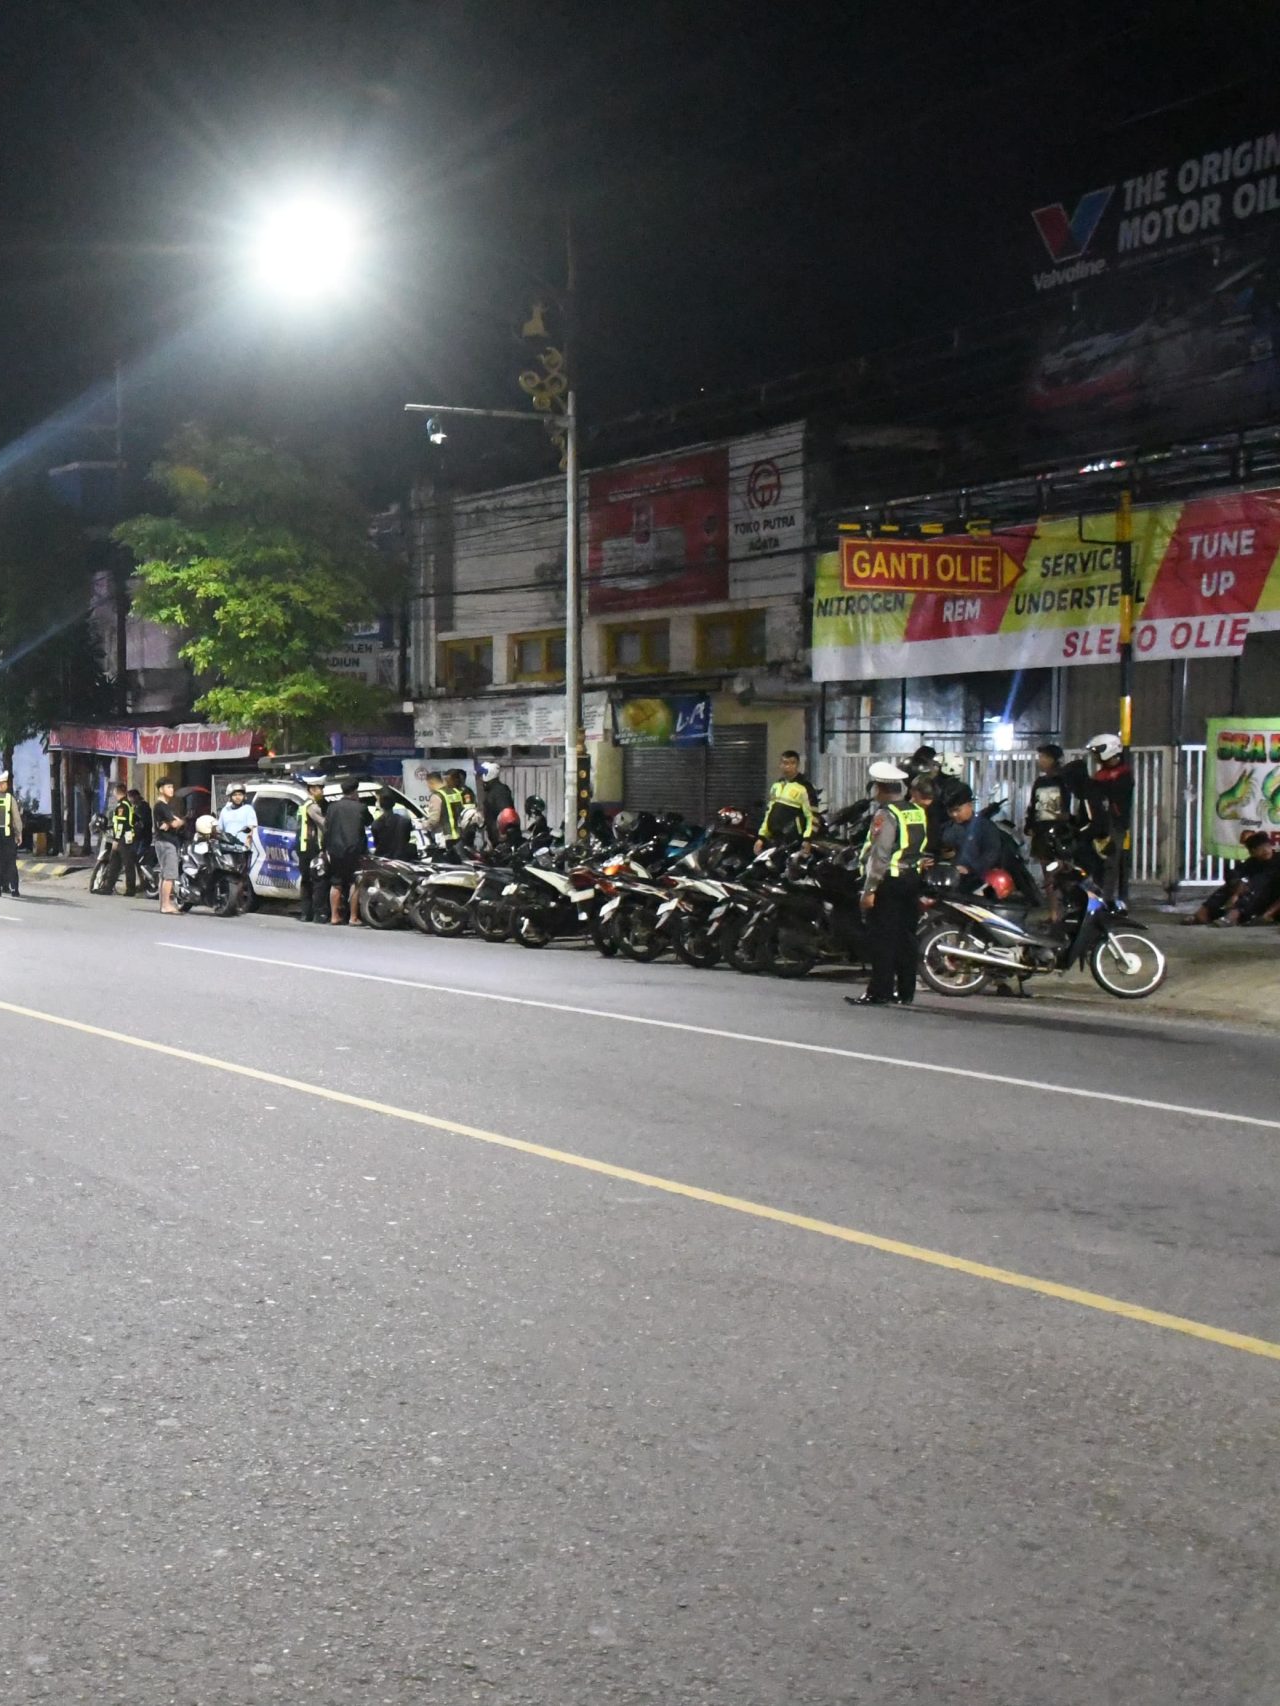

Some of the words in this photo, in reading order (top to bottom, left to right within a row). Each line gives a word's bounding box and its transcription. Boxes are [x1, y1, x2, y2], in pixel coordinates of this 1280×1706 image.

[1123, 168, 1169, 212] THE
[1118, 194, 1222, 253] MOTOR
[1231, 175, 1280, 220] OIL
[1032, 257, 1106, 291] Valvoline
[762, 514, 796, 531] PUTRA
[1188, 528, 1256, 560] TUNE
[852, 550, 930, 581] GANTI
[936, 556, 994, 585] OLIE
[1014, 580, 1146, 617] UNDERSTEL
[1201, 571, 1236, 599] UP
[815, 592, 906, 618] NITROGEN
[942, 598, 981, 624] REM
[1170, 618, 1251, 651] OLIE
